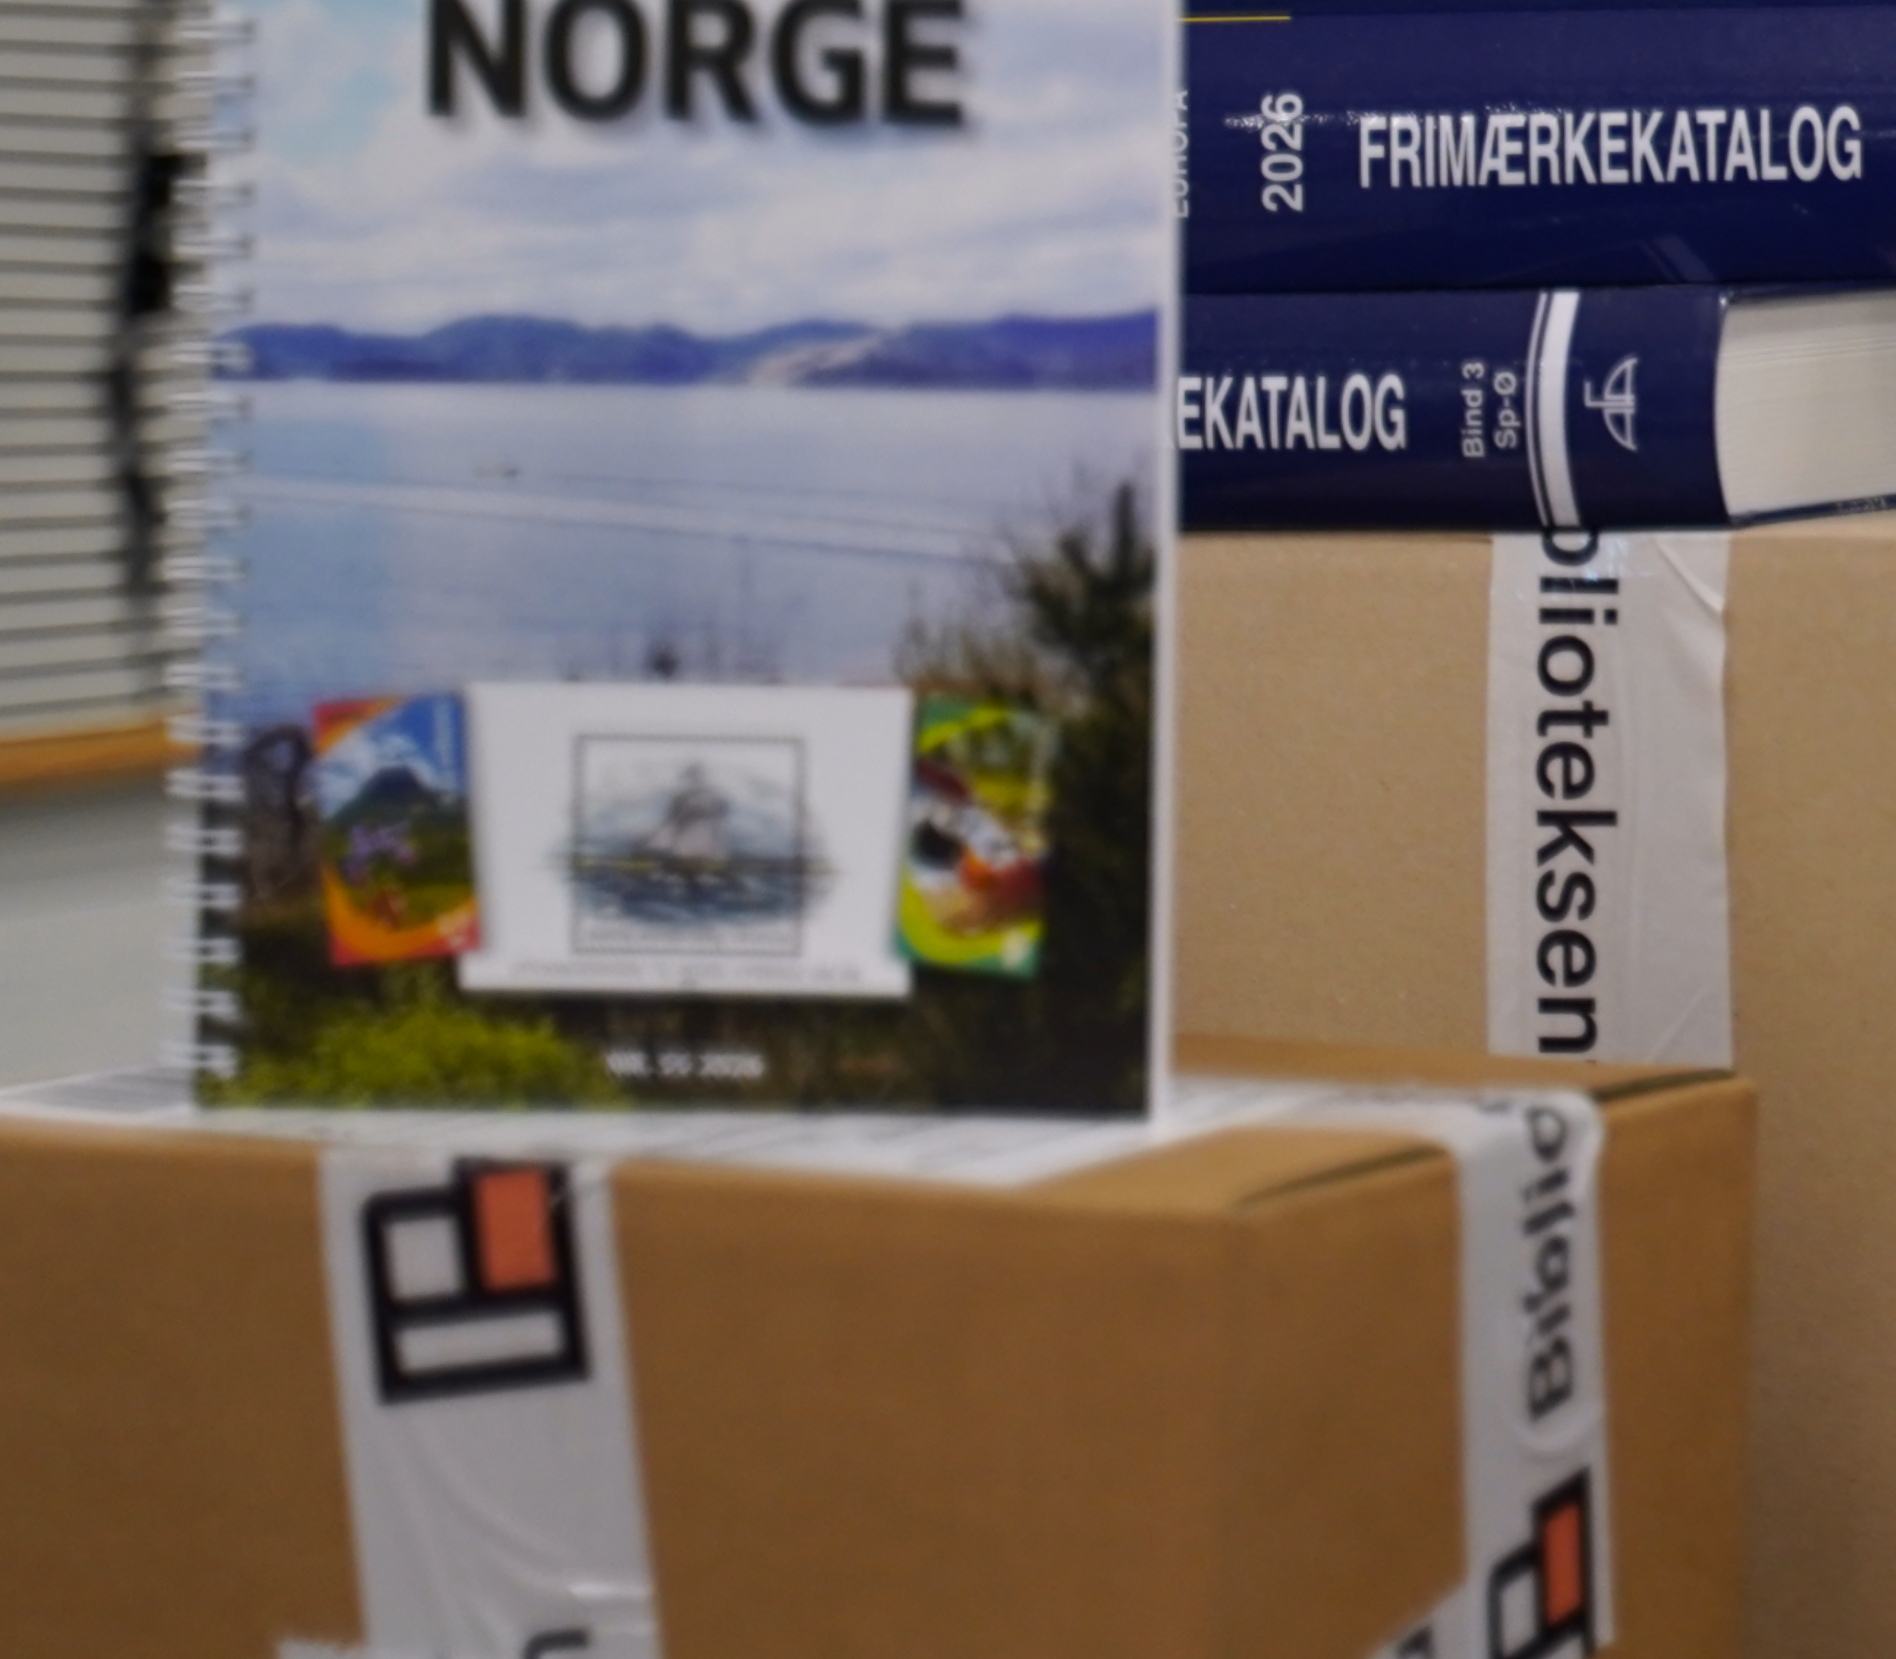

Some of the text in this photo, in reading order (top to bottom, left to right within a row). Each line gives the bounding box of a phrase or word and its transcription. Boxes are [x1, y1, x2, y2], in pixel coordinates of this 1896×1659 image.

[1260, 93, 1303, 213] 2026
[1358, 103, 1864, 190] FRIMÆRKEKATALOG
[1460, 360, 1486, 459] Bind 3
[1492, 370, 1522, 450] Sp-Ø
